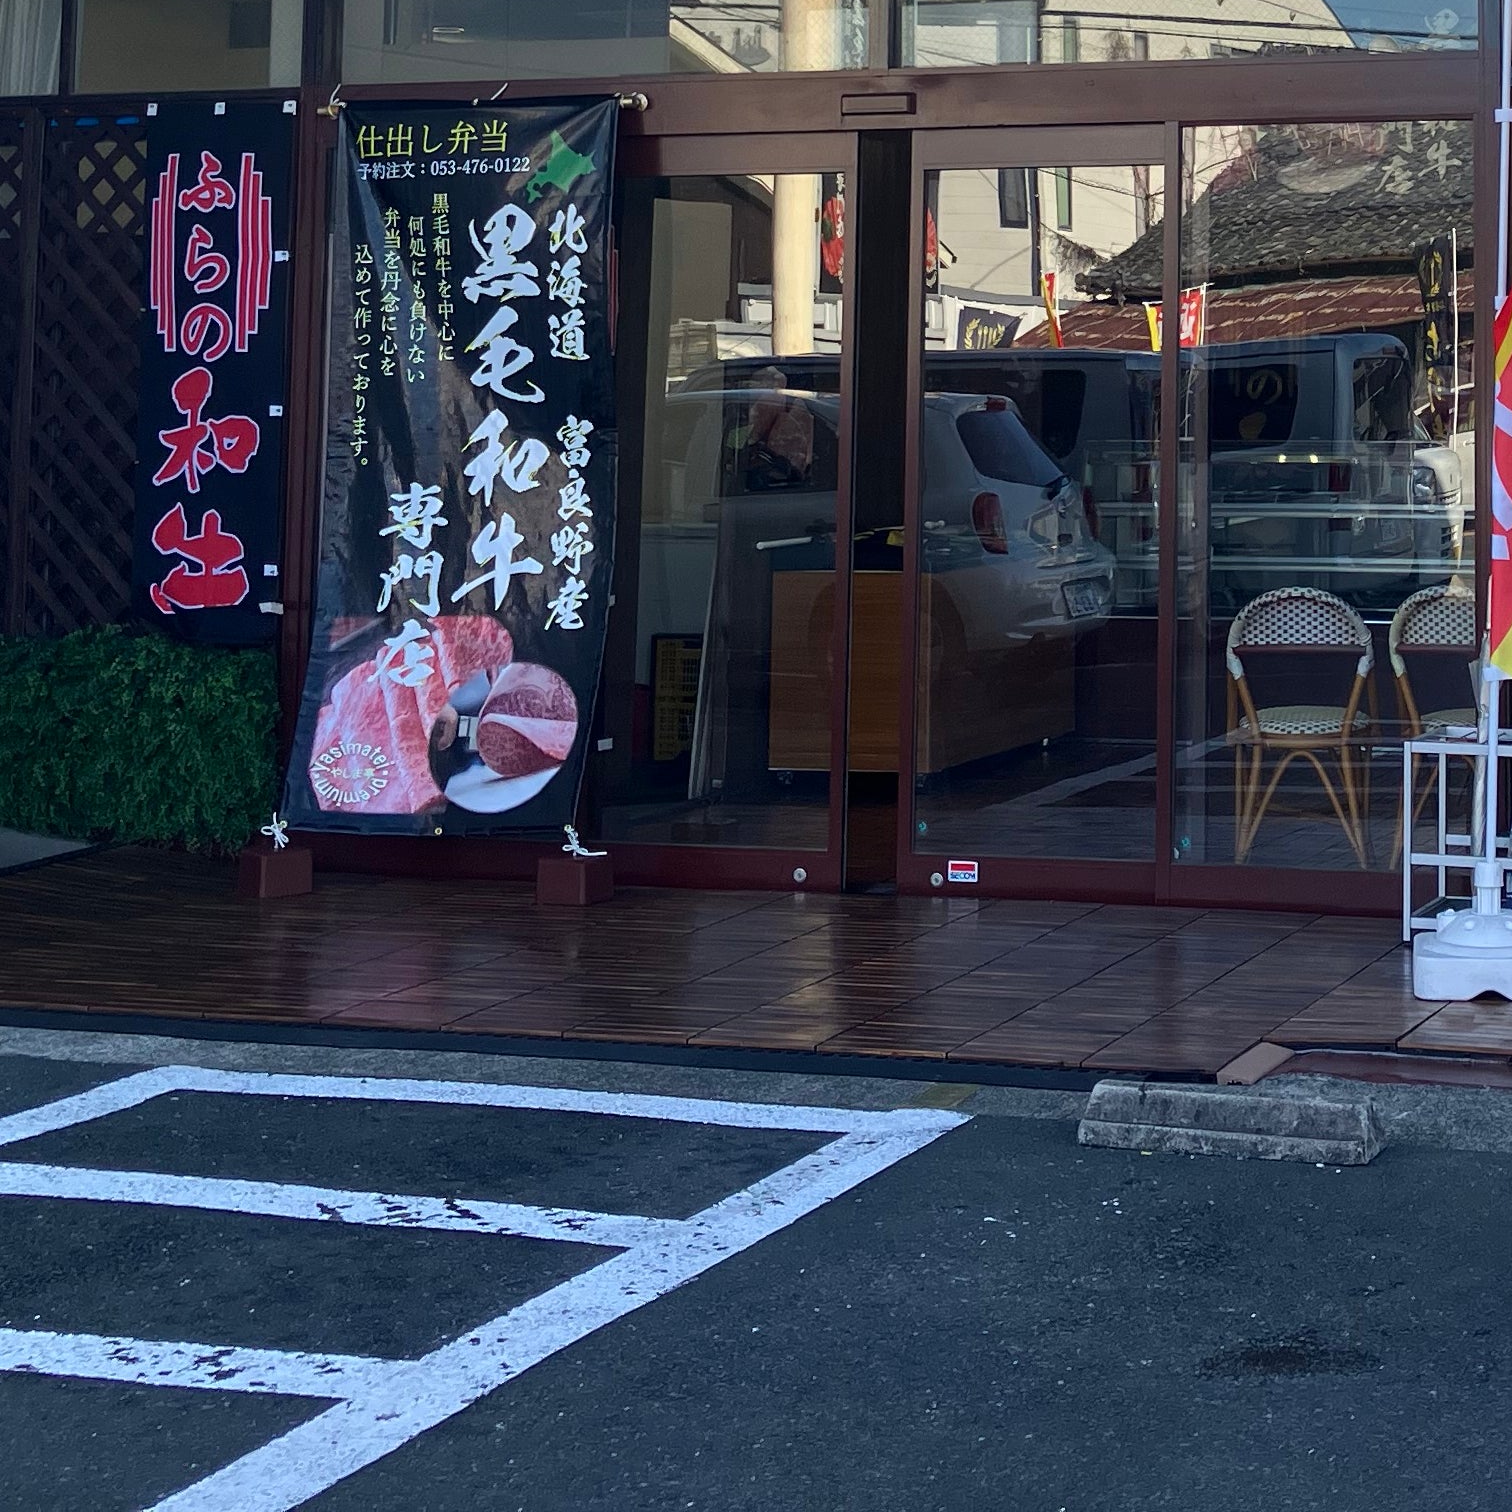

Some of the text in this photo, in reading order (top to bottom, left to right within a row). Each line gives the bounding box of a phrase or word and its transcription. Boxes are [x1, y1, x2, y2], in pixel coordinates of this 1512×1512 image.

[356, 119, 508, 159] 仕出し弁当
[349, 244, 374, 467] 込めて作っております。
[379, 206, 402, 377] 弁当を丹念に心を
[407, 215, 427, 384] 何処にも負けない
[431, 193, 456, 362] 黒毛和牛を中心に
[547, 203, 591, 361] 北海道
[451, 202, 551, 611] 黒毛和牛
[366, 481, 449, 688] 専門店
